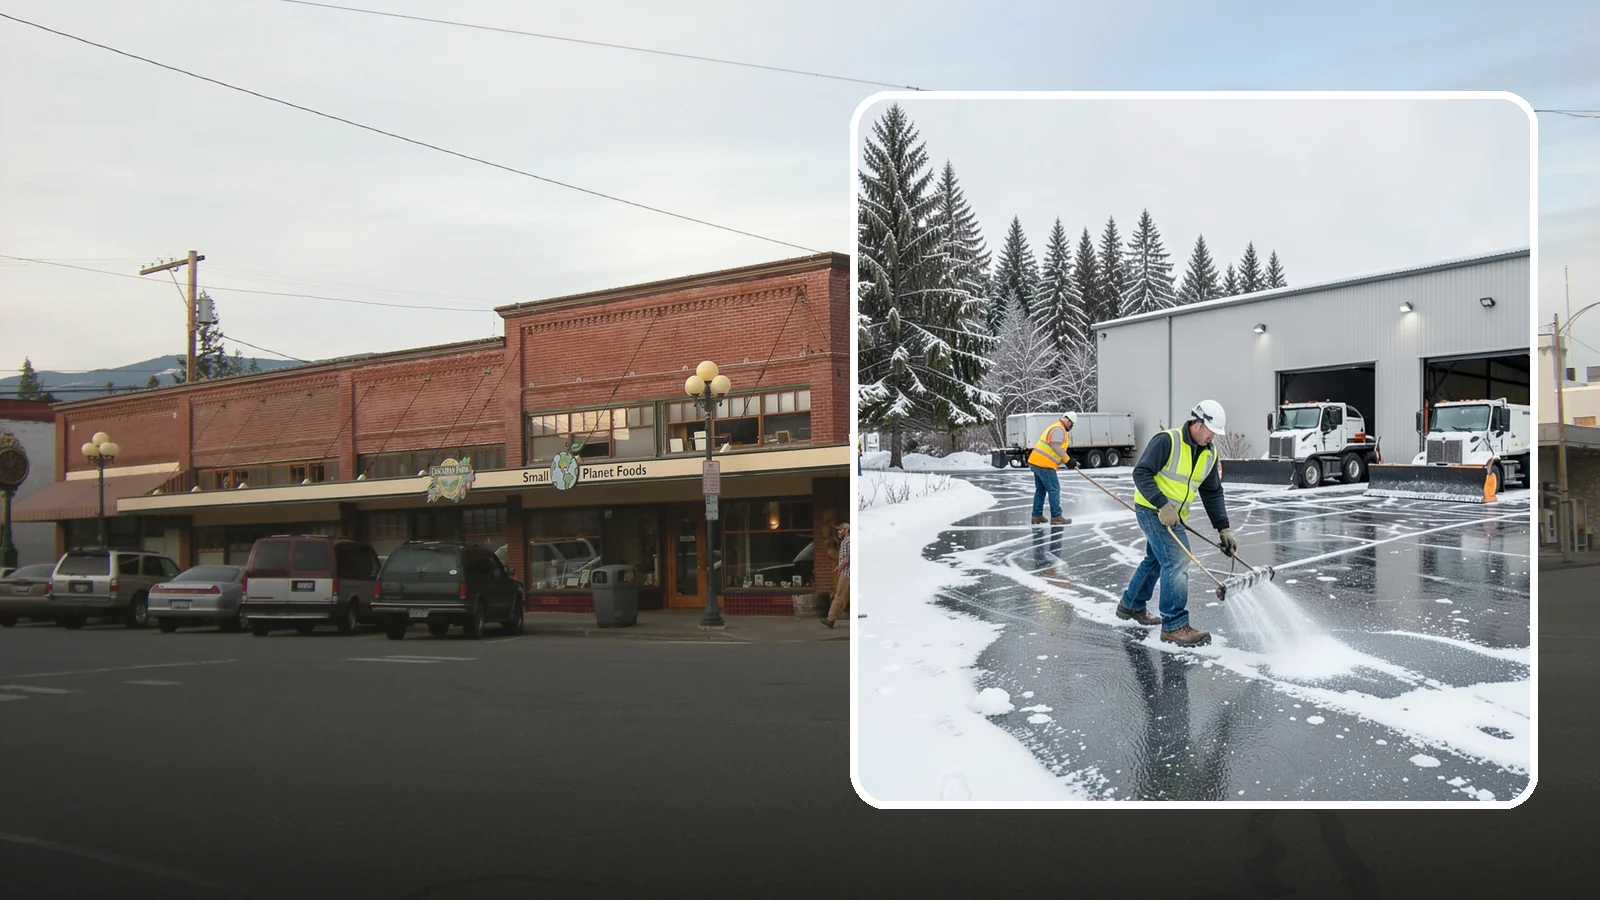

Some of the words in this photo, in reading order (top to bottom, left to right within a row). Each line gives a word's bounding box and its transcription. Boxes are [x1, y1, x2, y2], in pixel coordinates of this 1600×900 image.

[523, 471, 549, 483] Small
[583, 467, 614, 479] Planet
[617, 463, 647, 477] Foods
